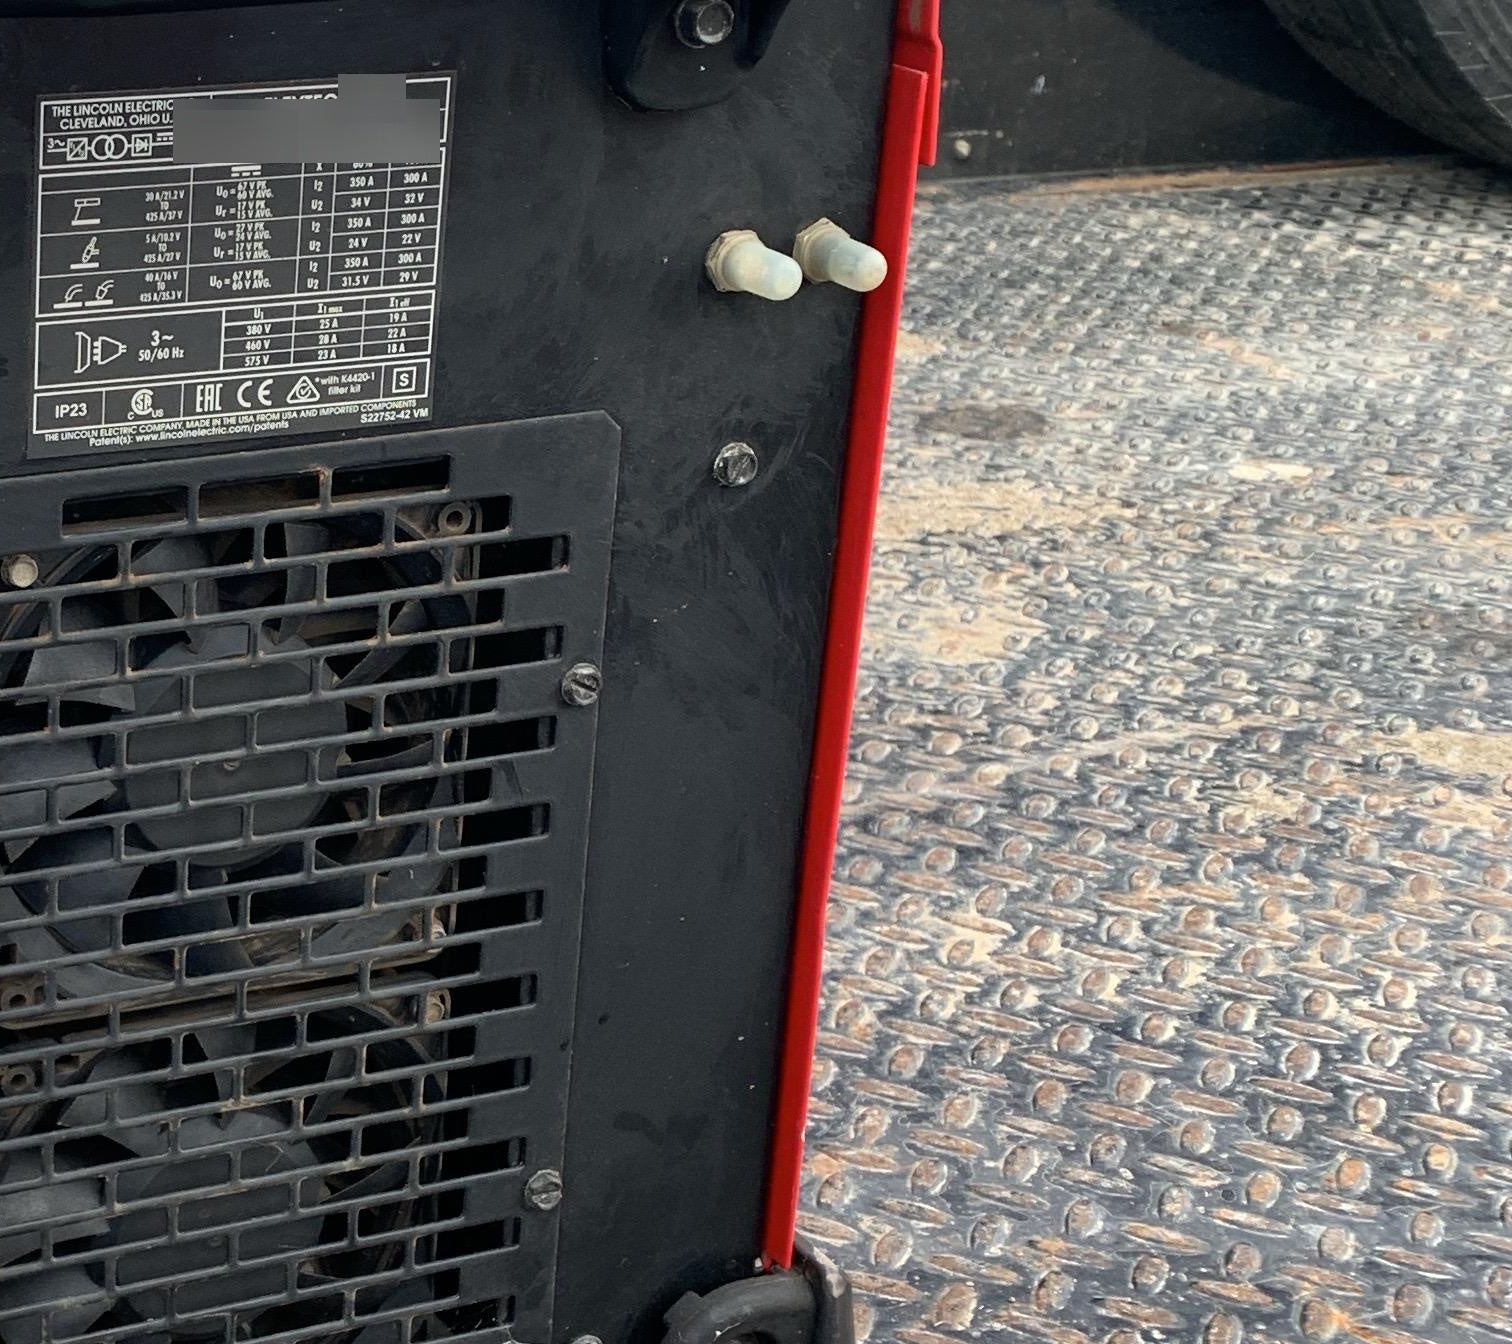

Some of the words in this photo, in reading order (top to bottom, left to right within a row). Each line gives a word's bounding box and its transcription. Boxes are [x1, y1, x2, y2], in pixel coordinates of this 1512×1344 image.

[52, 106, 71, 118] THE
[74, 102, 123, 116] LINCOLN
[60, 116, 127, 130] CLEVELAND,
[129, 114, 160, 126] OHIO
[350, 177, 366, 188] 350
[368, 176, 374, 186] A
[421, 172, 427, 182] A
[364, 196, 371, 207] V
[404, 194, 416, 204] 32
[418, 193, 424, 203] V
[347, 218, 363, 229] 350
[365, 217, 371, 227] A
[418, 213, 425, 223] A
[348, 238, 360, 249] 24
[361, 238, 368, 247] V
[402, 234, 413, 244] 22
[414, 233, 421, 243] V
[344, 258, 360, 268] 350
[362, 257, 369, 267] A
[415, 252, 422, 262] A
[342, 276, 360, 287] 31.5
[362, 275, 369, 285] V
[412, 271, 419, 281] V
[400, 312, 407, 322] A
[319, 319, 330, 329] 25
[331, 318, 338, 328] A
[246, 325, 262, 335] 380
[264, 324, 272, 334] V
[399, 328, 406, 338] A
[330, 334, 338, 344] A
[245, 340, 262, 351] 460
[263, 339, 271, 350] V
[398, 342, 406, 353] A
[138, 347, 169, 363] 50/60
[172, 346, 184, 359] Hz
[318, 350, 329, 360] 23
[330, 349, 337, 359] A
[245, 356, 261, 366] 575
[262, 355, 270, 365] V
[341, 372, 375, 384] K4420-1
[399, 373, 409, 387] S
[237, 379, 273, 407] CE
[55, 403, 88, 419] IP23
[360, 411, 411, 424] S22752-42
[413, 408, 428, 418] VM
[45, 434, 59, 442] THE
[61, 430, 98, 441] LINCOLN
[100, 426, 138, 437] ELECTRIC
[186, 419, 210, 429] MADE
[212, 418, 221, 427] IN
[223, 417, 236, 425] THE
[238, 414, 254, 424] USA
[256, 412, 280, 422] FROM
[282, 411, 297, 420] USA
[299, 409, 318, 418] AND
[319, 406, 358, 416] IMPORTED
[360, 400, 416, 412] COMPONENTS
[89, 436, 133, 447] Patent(s):
